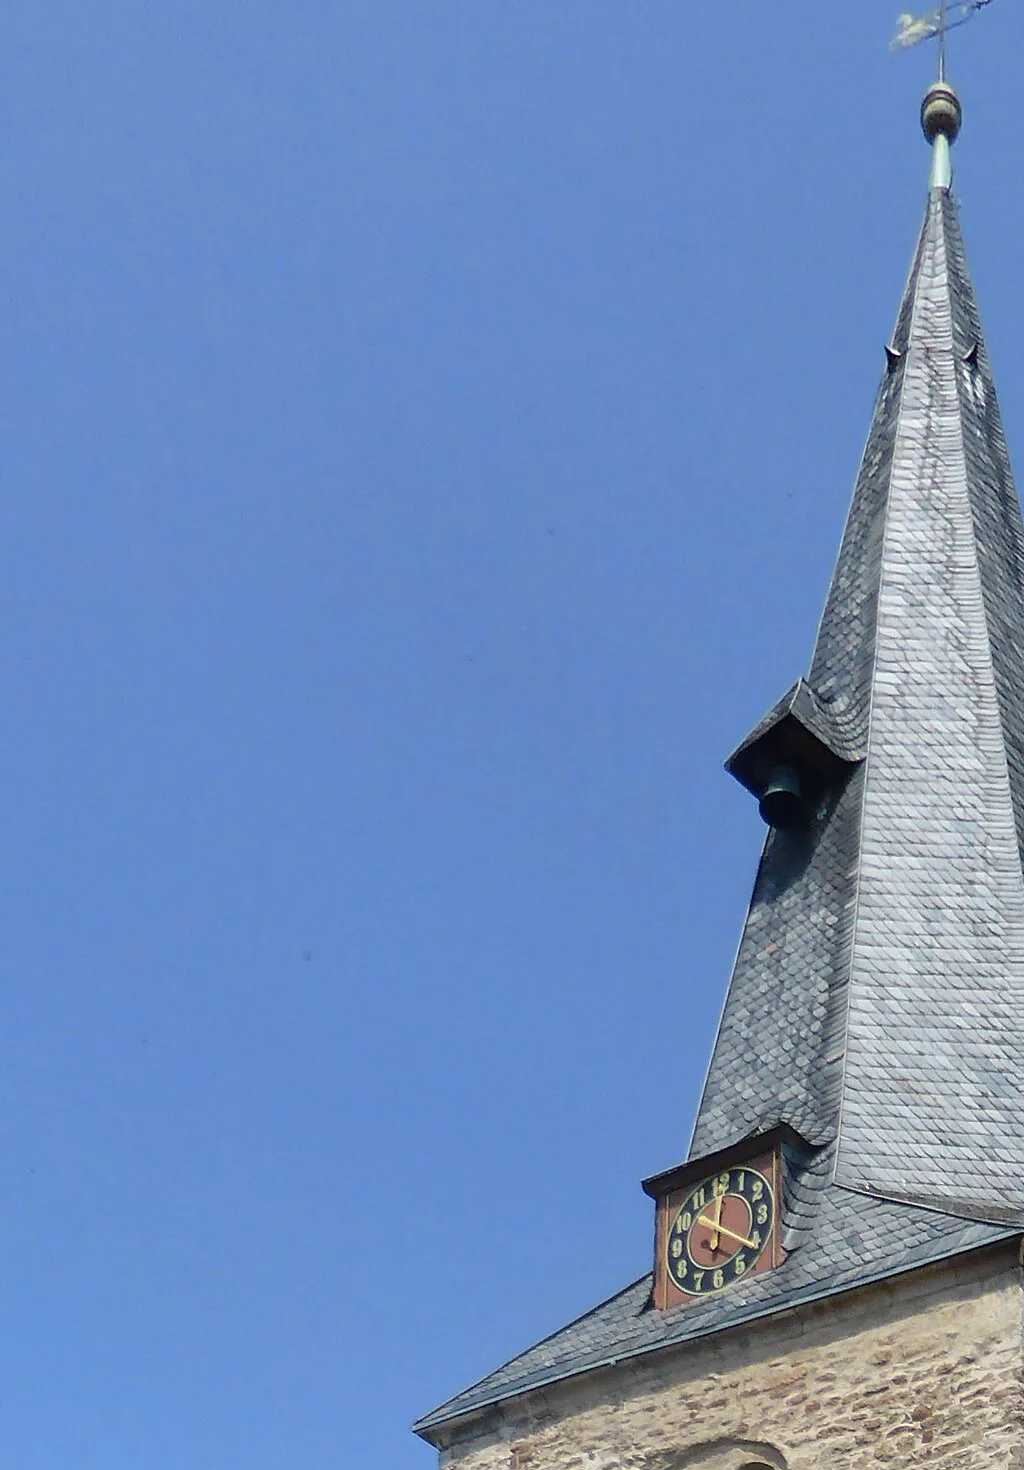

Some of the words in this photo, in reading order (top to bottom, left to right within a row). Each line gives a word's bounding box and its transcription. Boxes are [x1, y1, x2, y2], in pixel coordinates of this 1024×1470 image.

[738, 1172, 745, 1191] 1
[692, 1187, 705, 1210] 11
[752, 1182, 763, 1202] 2
[676, 1212, 691, 1234] 10
[757, 1204, 768, 1225] 3
[672, 1239, 682, 1258] 9
[677, 1260, 687, 1278] 8
[735, 1255, 746, 1274] 5
[694, 1272, 704, 1291] 7
[714, 1270, 723, 1288] 6
